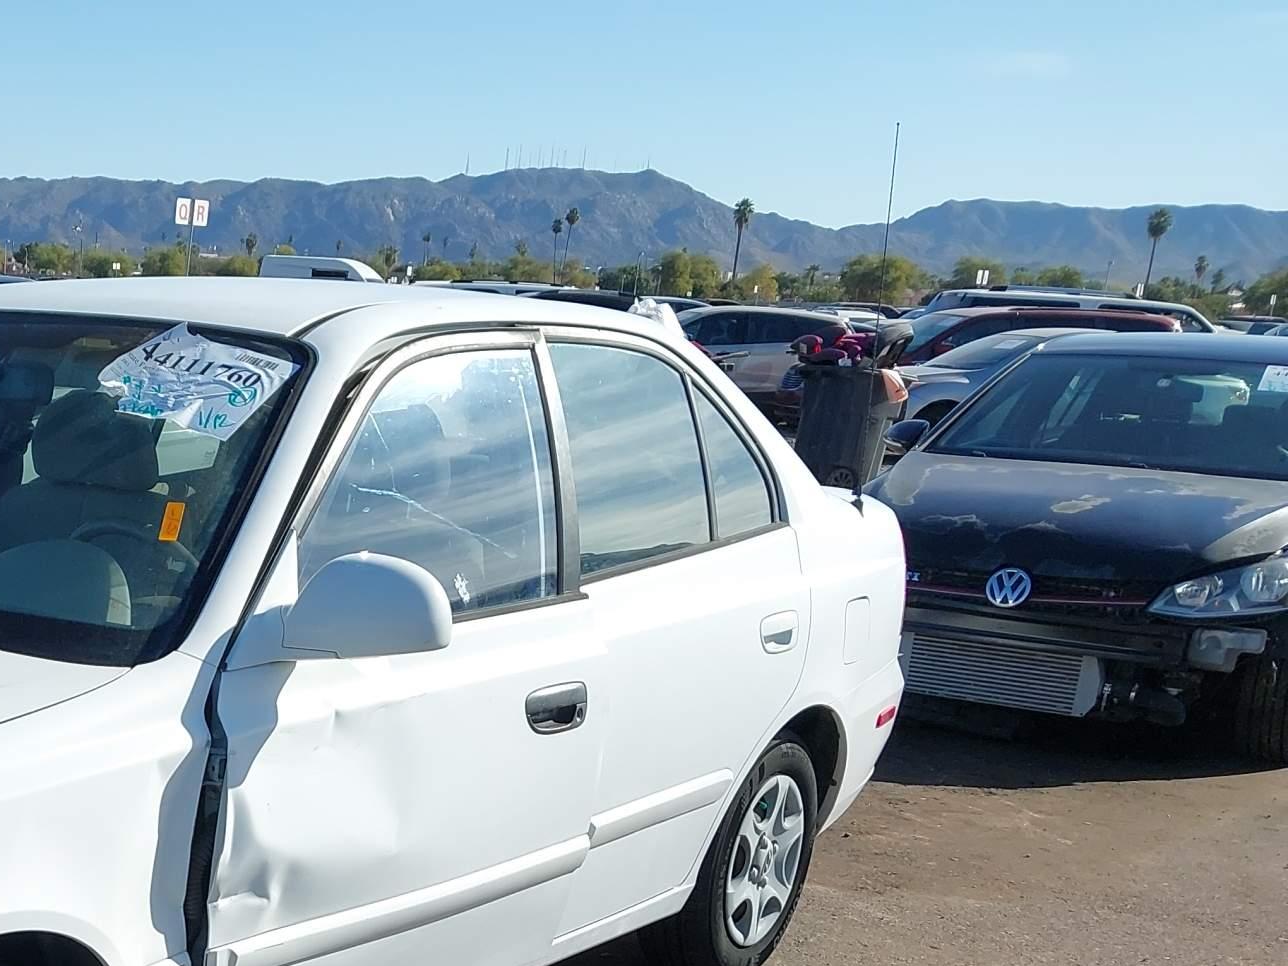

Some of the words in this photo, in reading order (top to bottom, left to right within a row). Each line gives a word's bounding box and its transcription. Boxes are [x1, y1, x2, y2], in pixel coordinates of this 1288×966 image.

[178, 202, 188, 220] Q
[196, 204, 206, 223] R
[141, 341, 262, 389] 44111760
